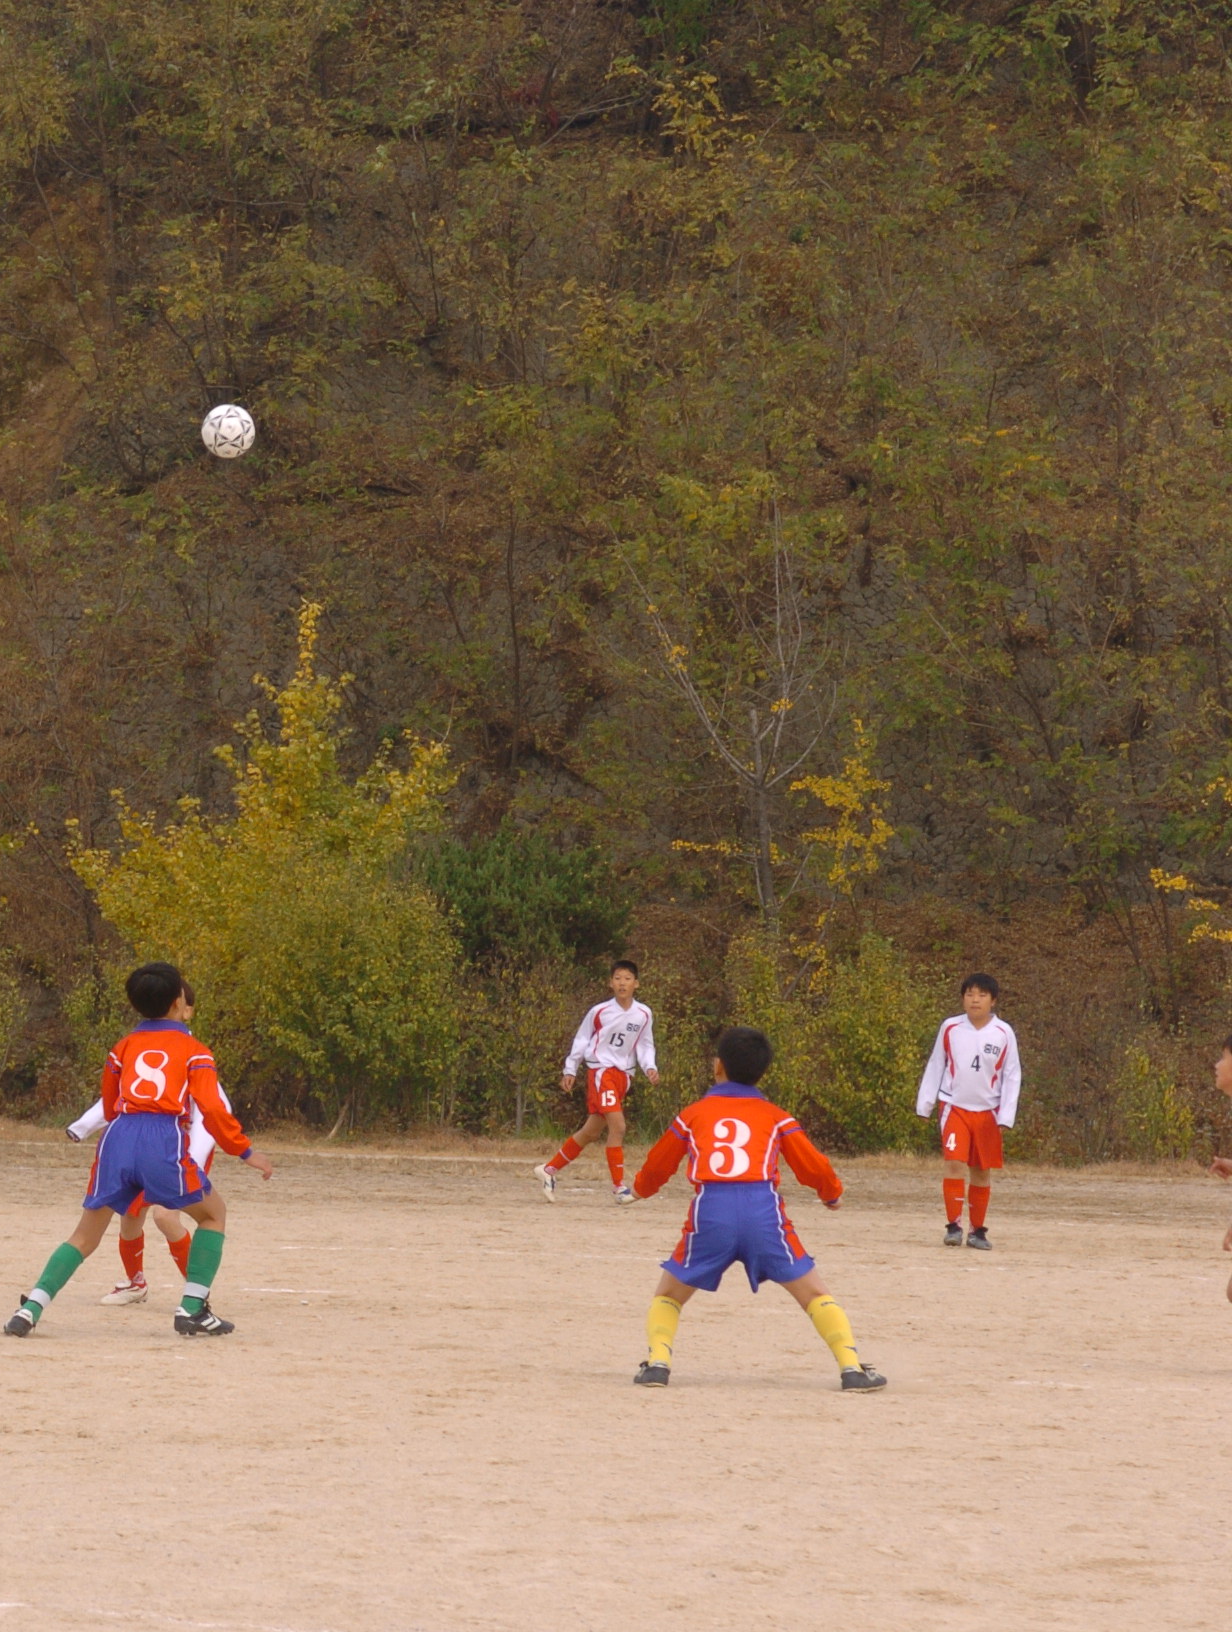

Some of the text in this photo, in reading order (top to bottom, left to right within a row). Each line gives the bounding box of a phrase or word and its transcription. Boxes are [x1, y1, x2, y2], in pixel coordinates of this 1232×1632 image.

[609, 1032, 626, 1047] 15
[971, 1054, 981, 1072] 4
[130, 1049, 169, 1102] 8
[601, 1090, 617, 1107] 15
[709, 1117, 752, 1178] 3
[946, 1132, 957, 1151] 4
